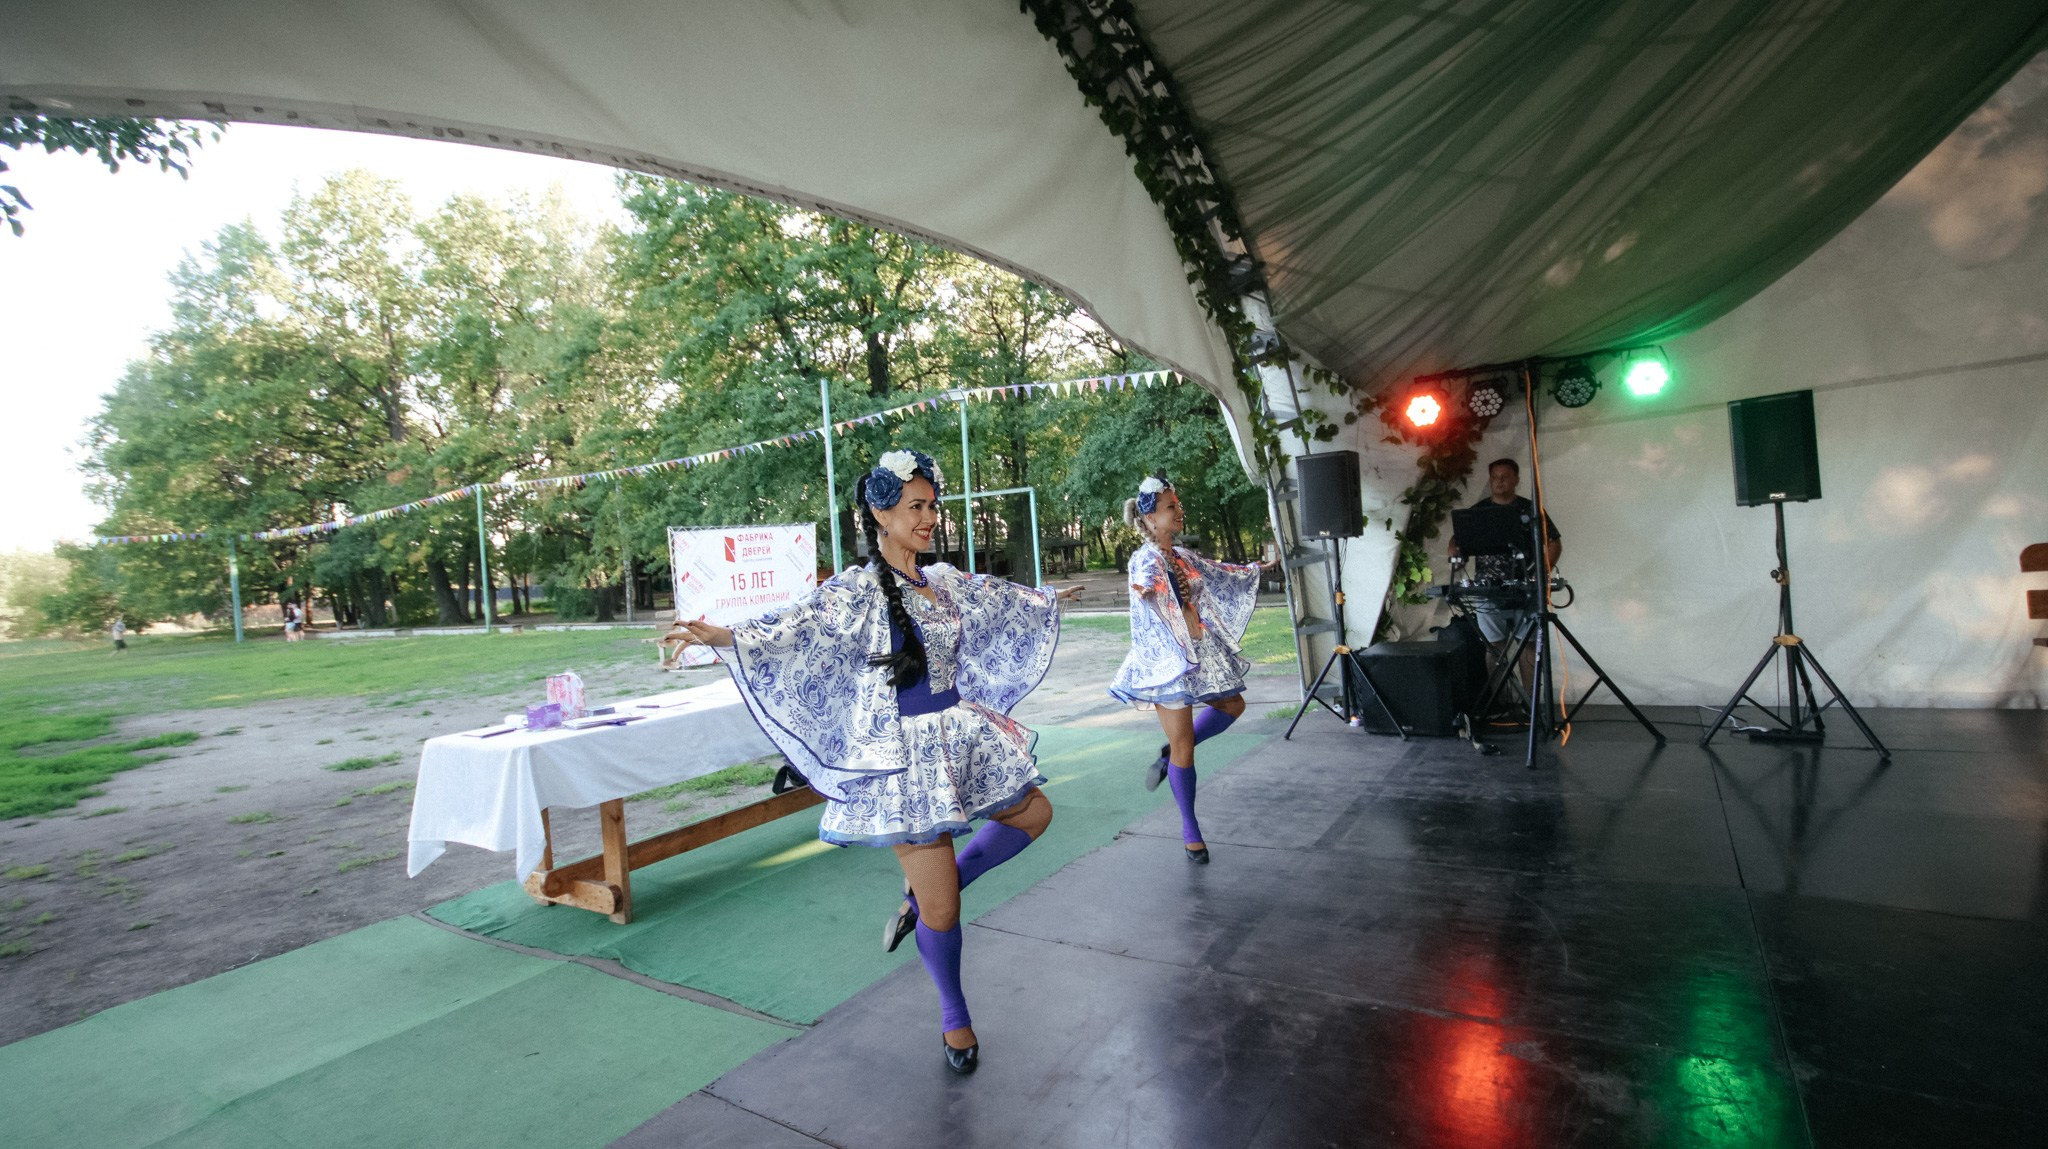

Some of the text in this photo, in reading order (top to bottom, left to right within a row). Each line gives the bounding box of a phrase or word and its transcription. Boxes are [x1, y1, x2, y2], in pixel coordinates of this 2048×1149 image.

[737, 532, 773, 542] ФАБРИКА
[742, 545, 771, 557] ДВЕРЕЙ
[731, 570, 775, 591] 15 ЛЕТ
[715, 596, 748, 609] ГРУППА
